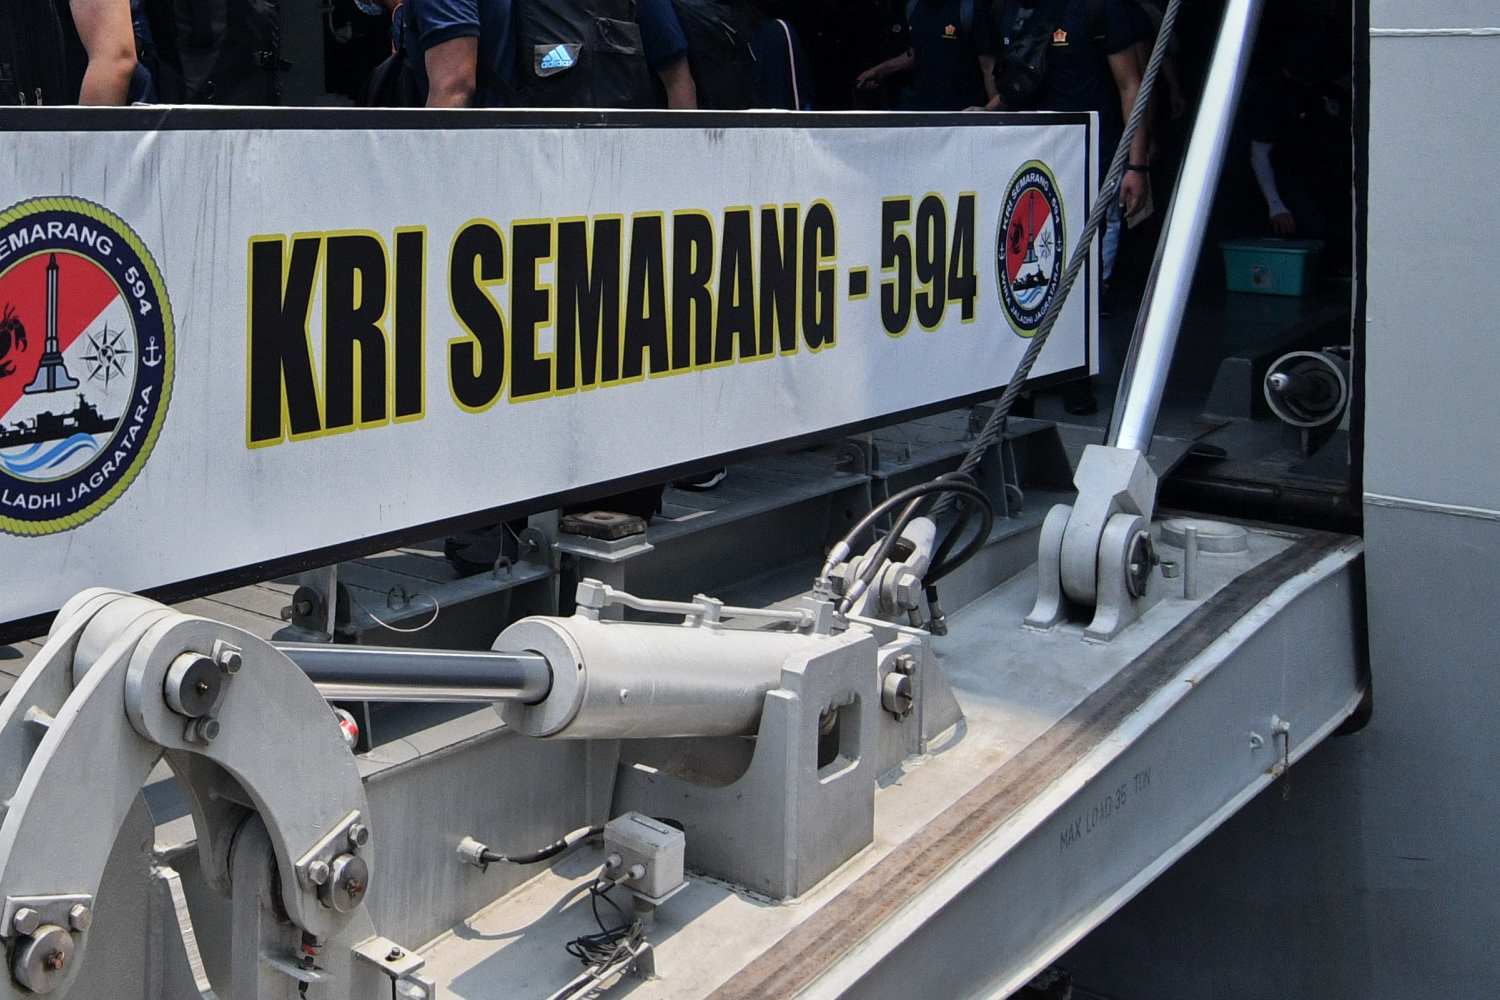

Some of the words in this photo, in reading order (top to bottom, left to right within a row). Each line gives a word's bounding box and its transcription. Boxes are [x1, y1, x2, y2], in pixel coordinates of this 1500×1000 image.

[541, 59, 574, 69] adidas
[124, 265, 152, 316] 594
[246, 225, 427, 449] KRI
[447, 199, 837, 413] SEMARANG
[879, 191, 978, 338] 594
[66, 384, 153, 503] JAGRATARA
[1060, 817, 1082, 853] MAX
